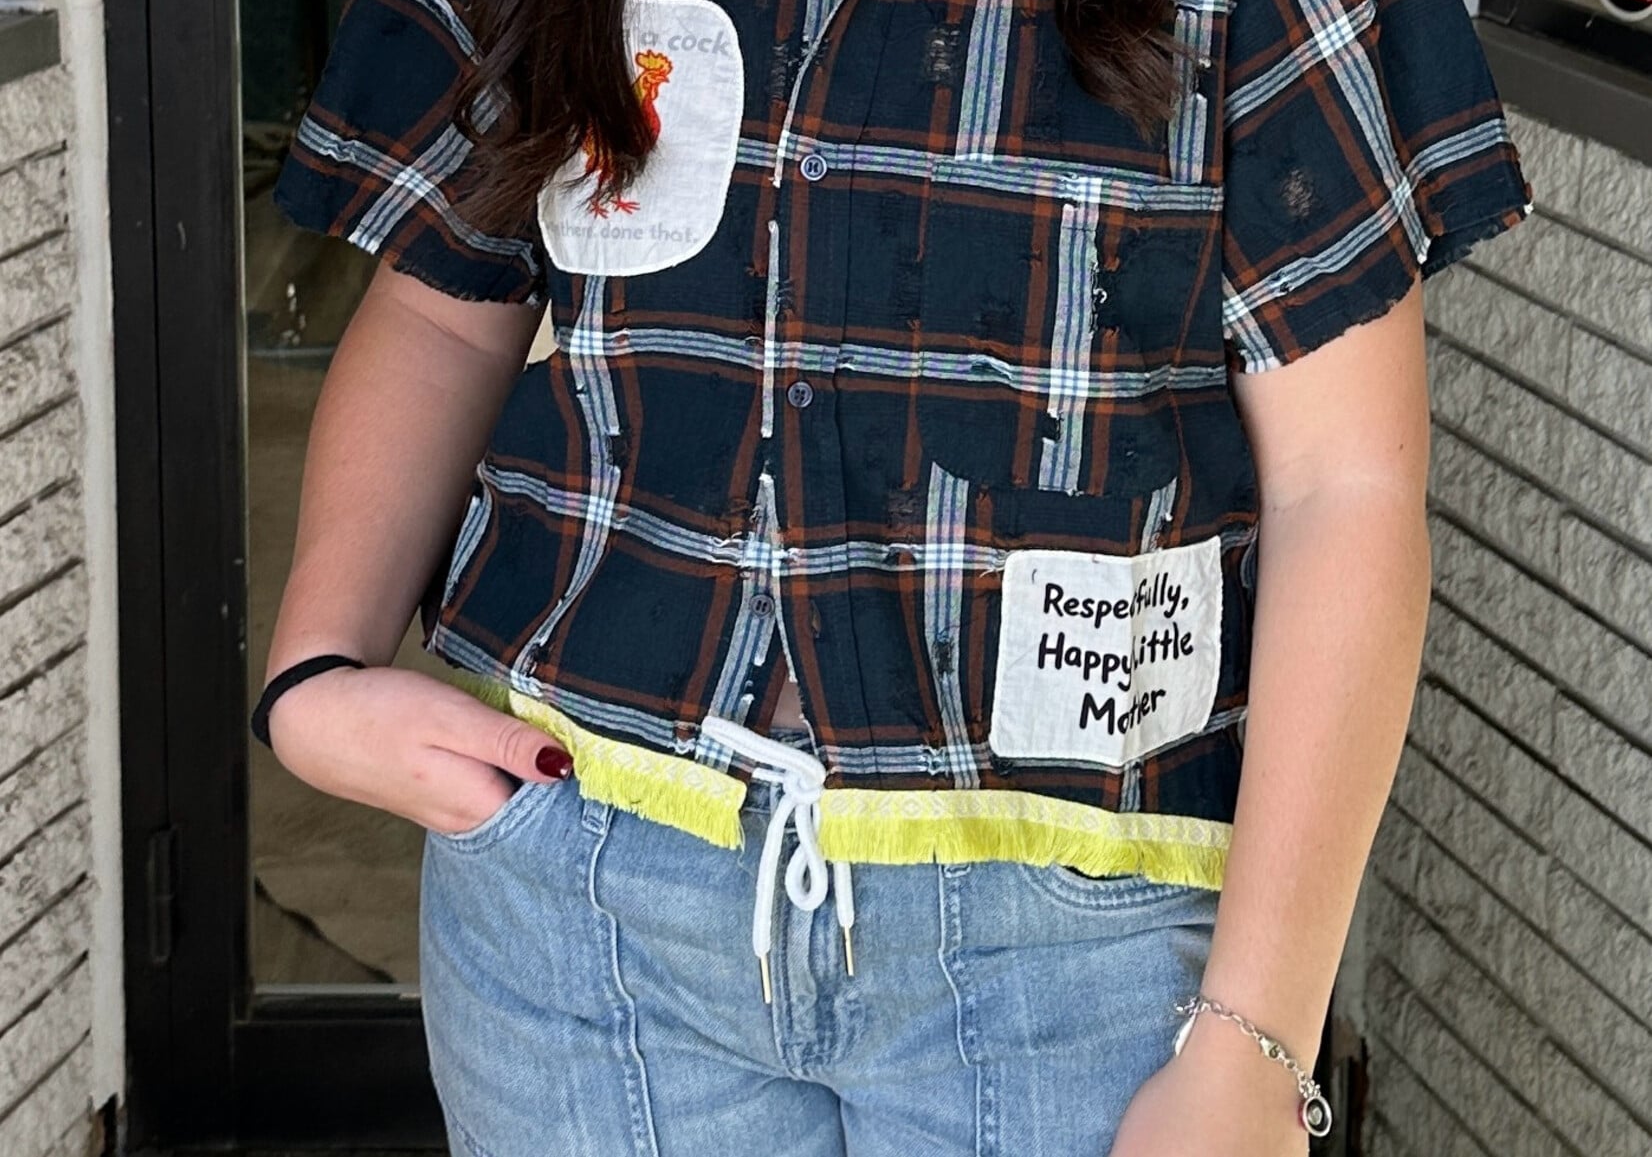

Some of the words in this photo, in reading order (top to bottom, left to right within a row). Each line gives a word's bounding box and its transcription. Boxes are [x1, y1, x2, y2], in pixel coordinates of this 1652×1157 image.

[668, 31, 730, 57] cock
[602, 223, 642, 240] done
[650, 223, 700, 243] that.
[1043, 572, 1189, 629] Respefully,
[1037, 631, 1132, 692] Happy
